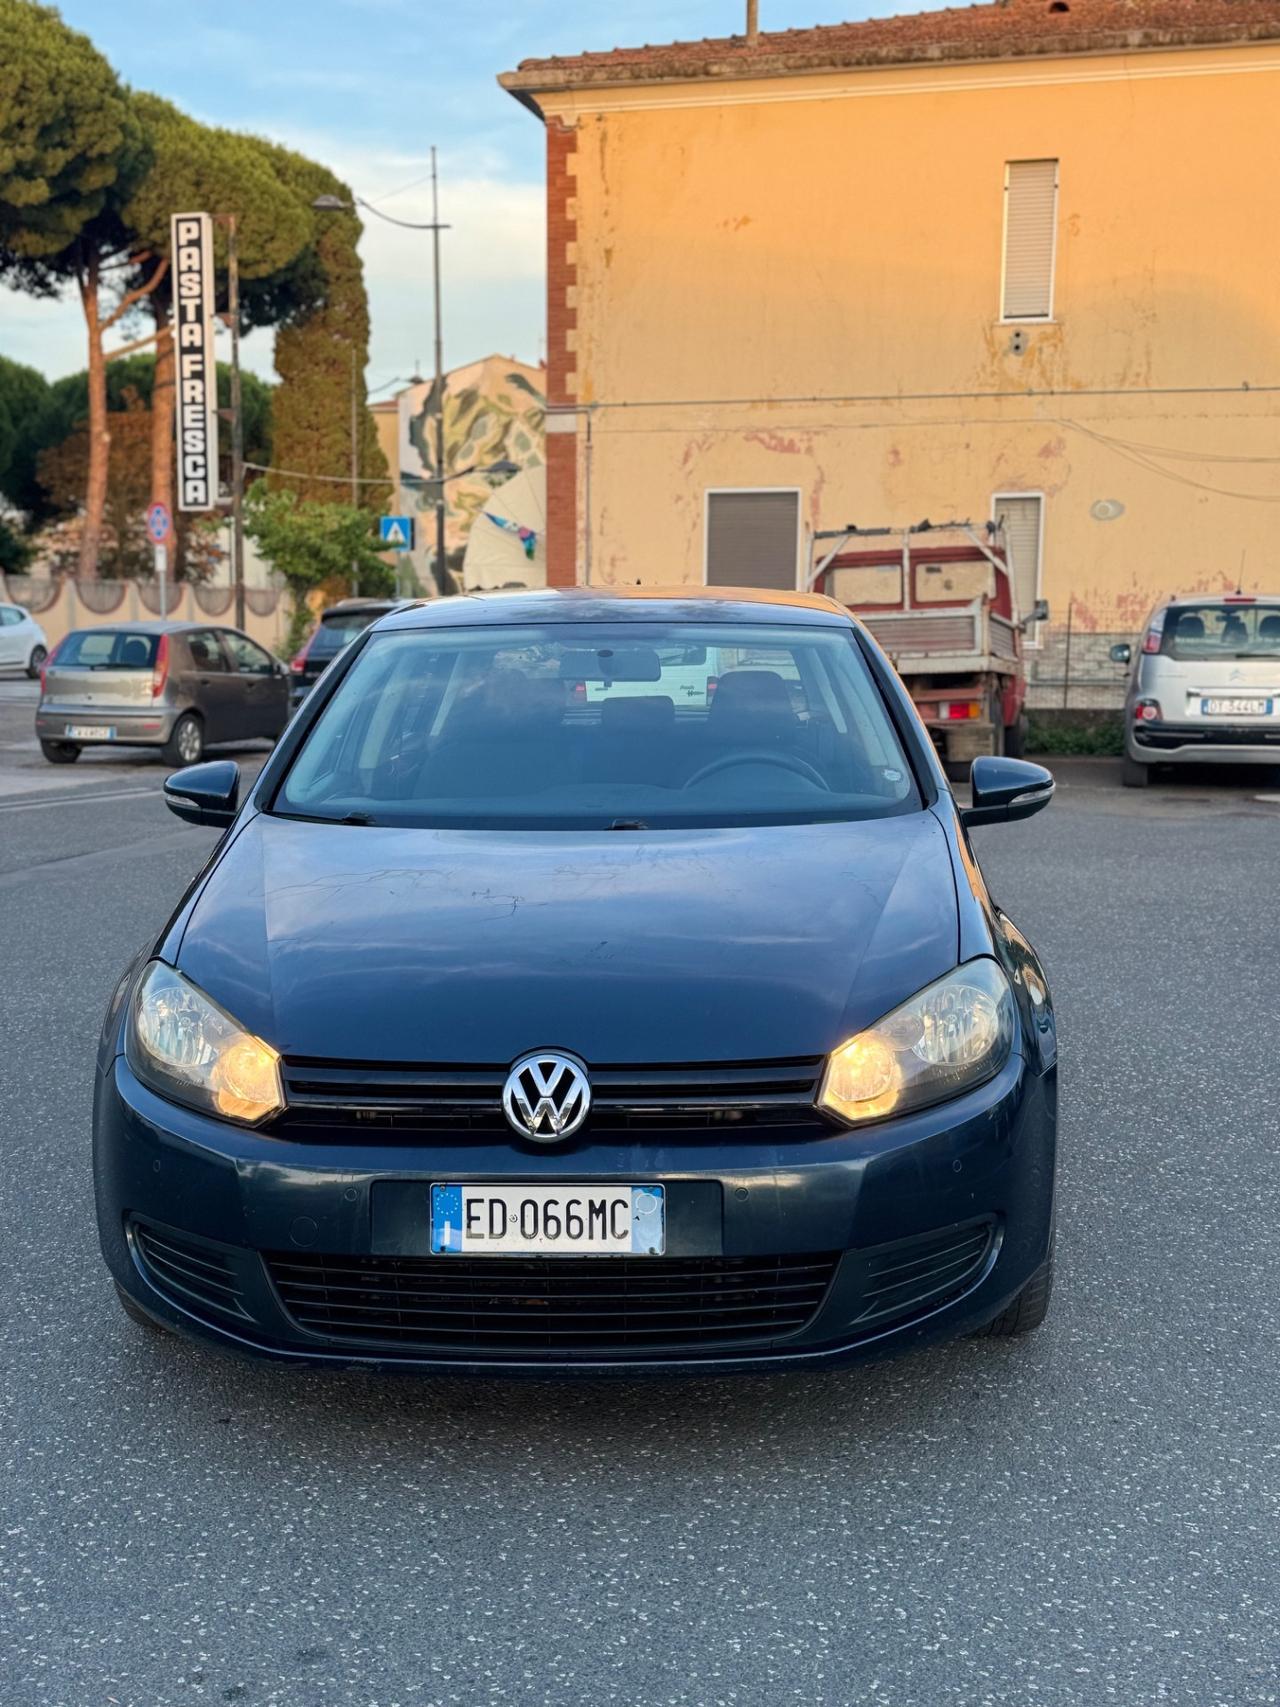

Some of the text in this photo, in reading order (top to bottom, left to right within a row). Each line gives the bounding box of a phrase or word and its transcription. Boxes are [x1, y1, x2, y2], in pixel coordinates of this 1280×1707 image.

[177, 221, 207, 504] PASTA FRESCA
[506, 1057, 587, 1137] VW
[466, 1198, 630, 1240] ED 066MC
